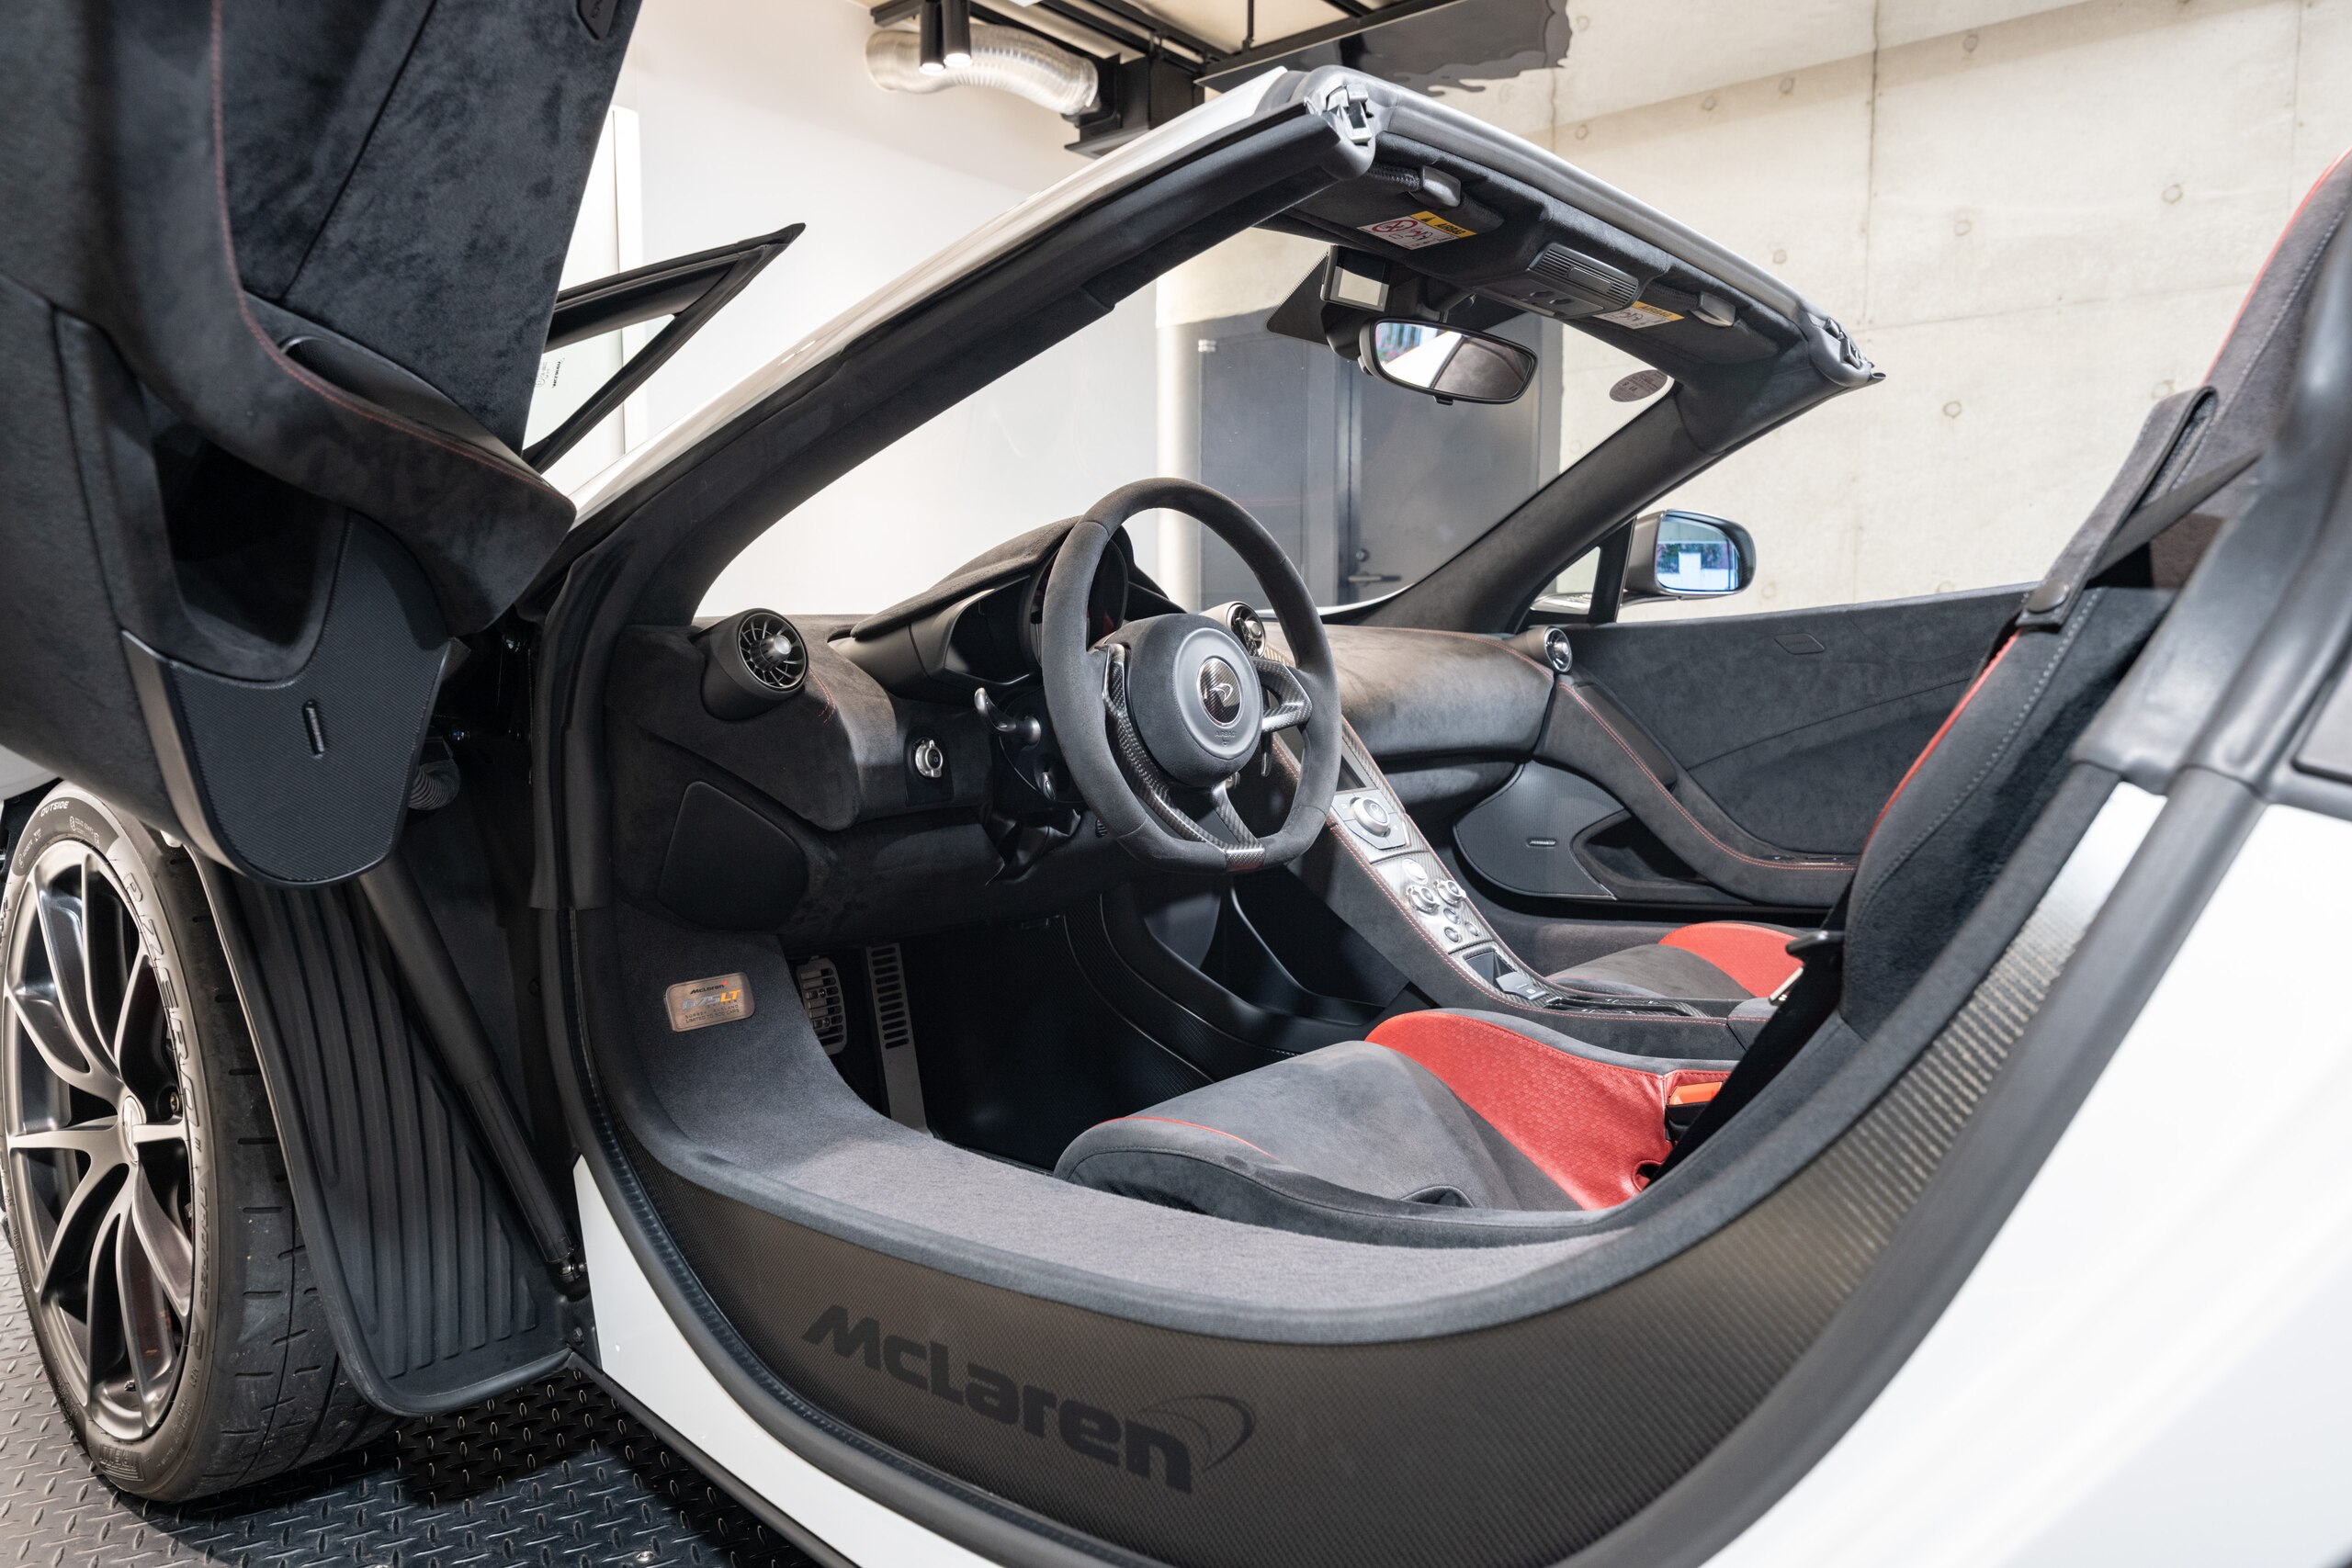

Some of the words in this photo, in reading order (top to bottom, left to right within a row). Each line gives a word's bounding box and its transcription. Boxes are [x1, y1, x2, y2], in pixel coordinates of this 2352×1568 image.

[40, 800, 70, 818] OUTSIDE
[690, 984, 724, 994] McLaren
[801, 1303, 1193, 1495] McLaren
